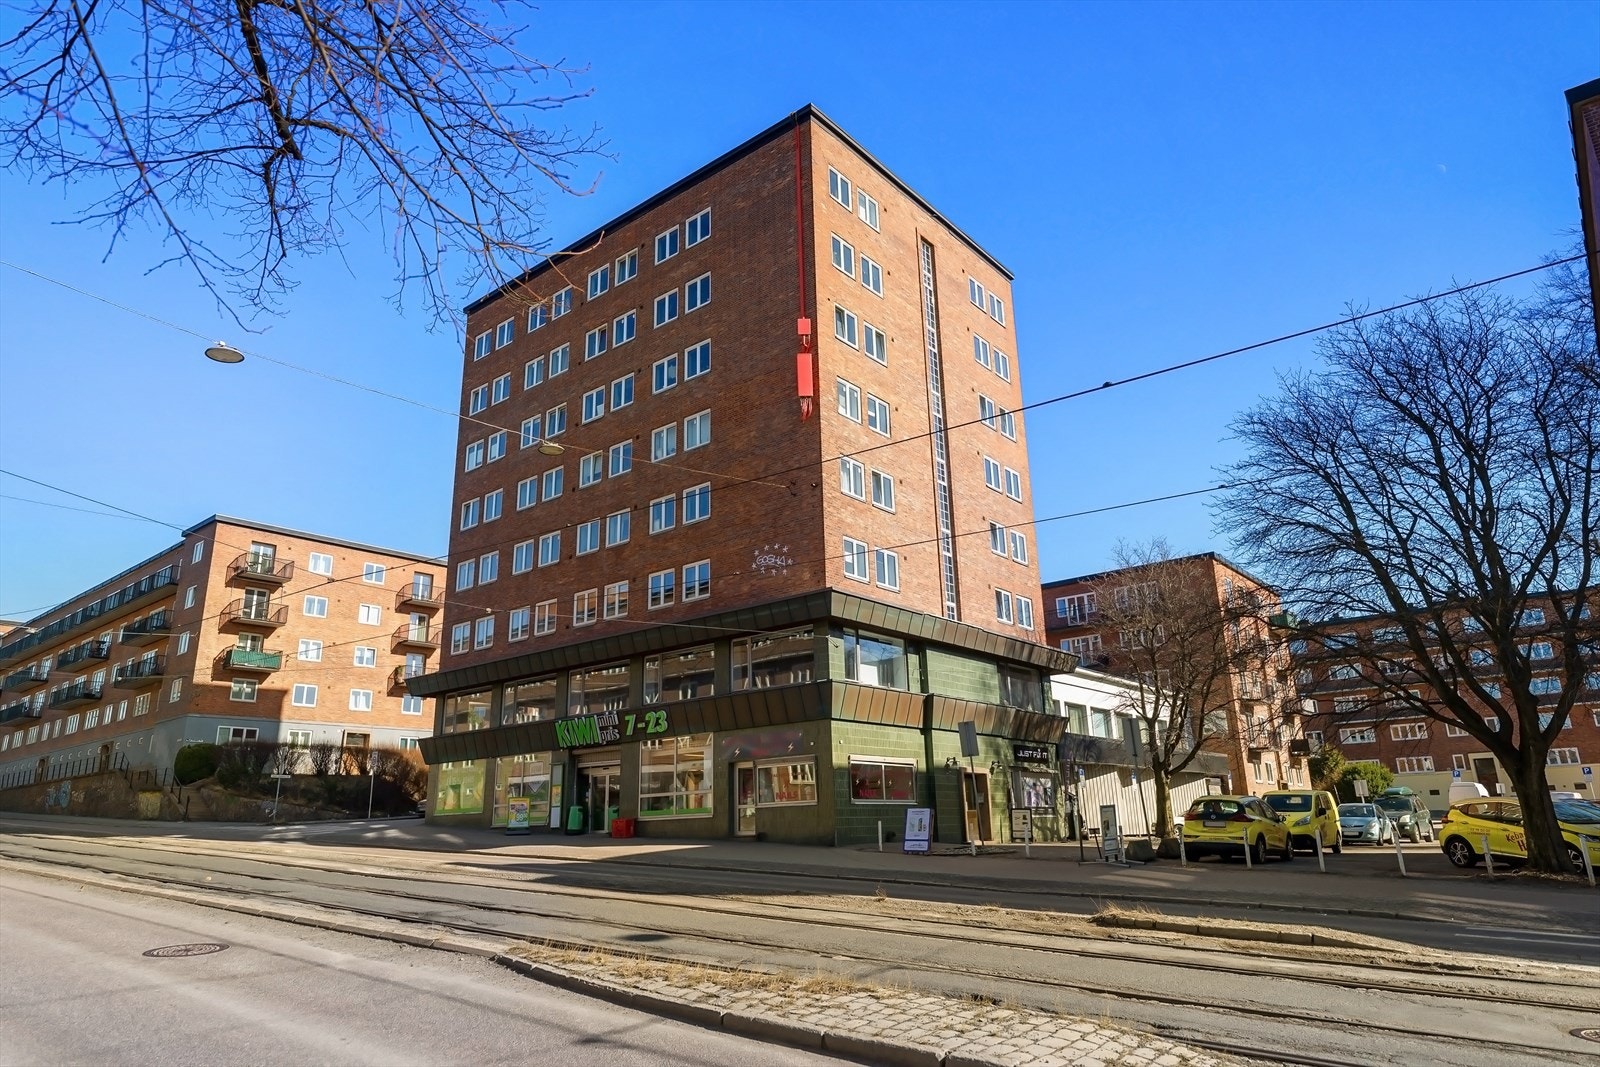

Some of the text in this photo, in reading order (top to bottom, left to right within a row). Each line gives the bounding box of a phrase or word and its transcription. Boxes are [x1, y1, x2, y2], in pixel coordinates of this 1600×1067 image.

[555, 711, 619, 748] KIWI mini
[625, 710, 668, 736] 7-23
[599, 727, 620, 745] pris
[1017, 750, 1032, 758] JUST
[1505, 832, 1524, 842] Keba
